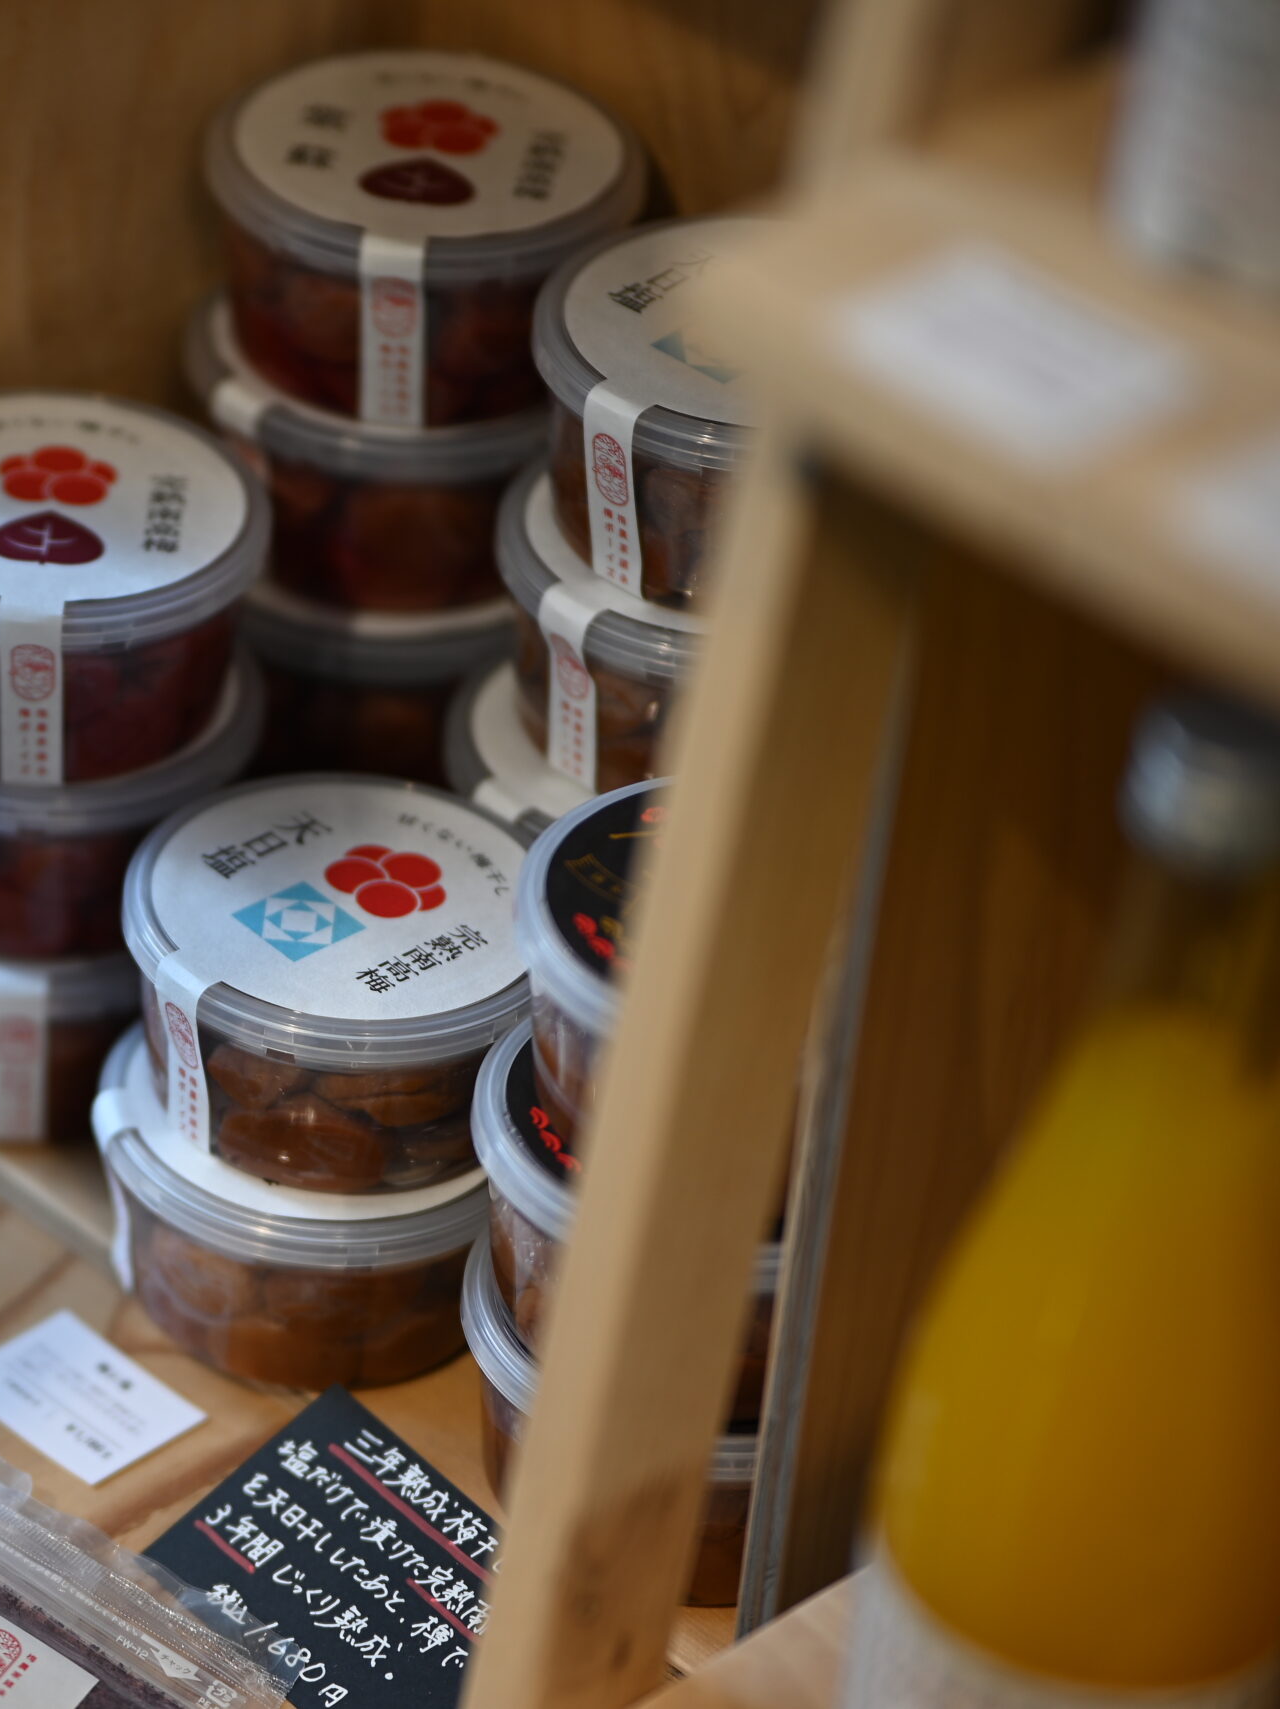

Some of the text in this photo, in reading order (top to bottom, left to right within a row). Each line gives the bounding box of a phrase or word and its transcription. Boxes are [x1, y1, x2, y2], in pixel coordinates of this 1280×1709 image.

[201, 811, 333, 880] 天日塩
[354, 924, 489, 995] 完熟南高梅
[116, 1635, 149, 1661] FW-12
